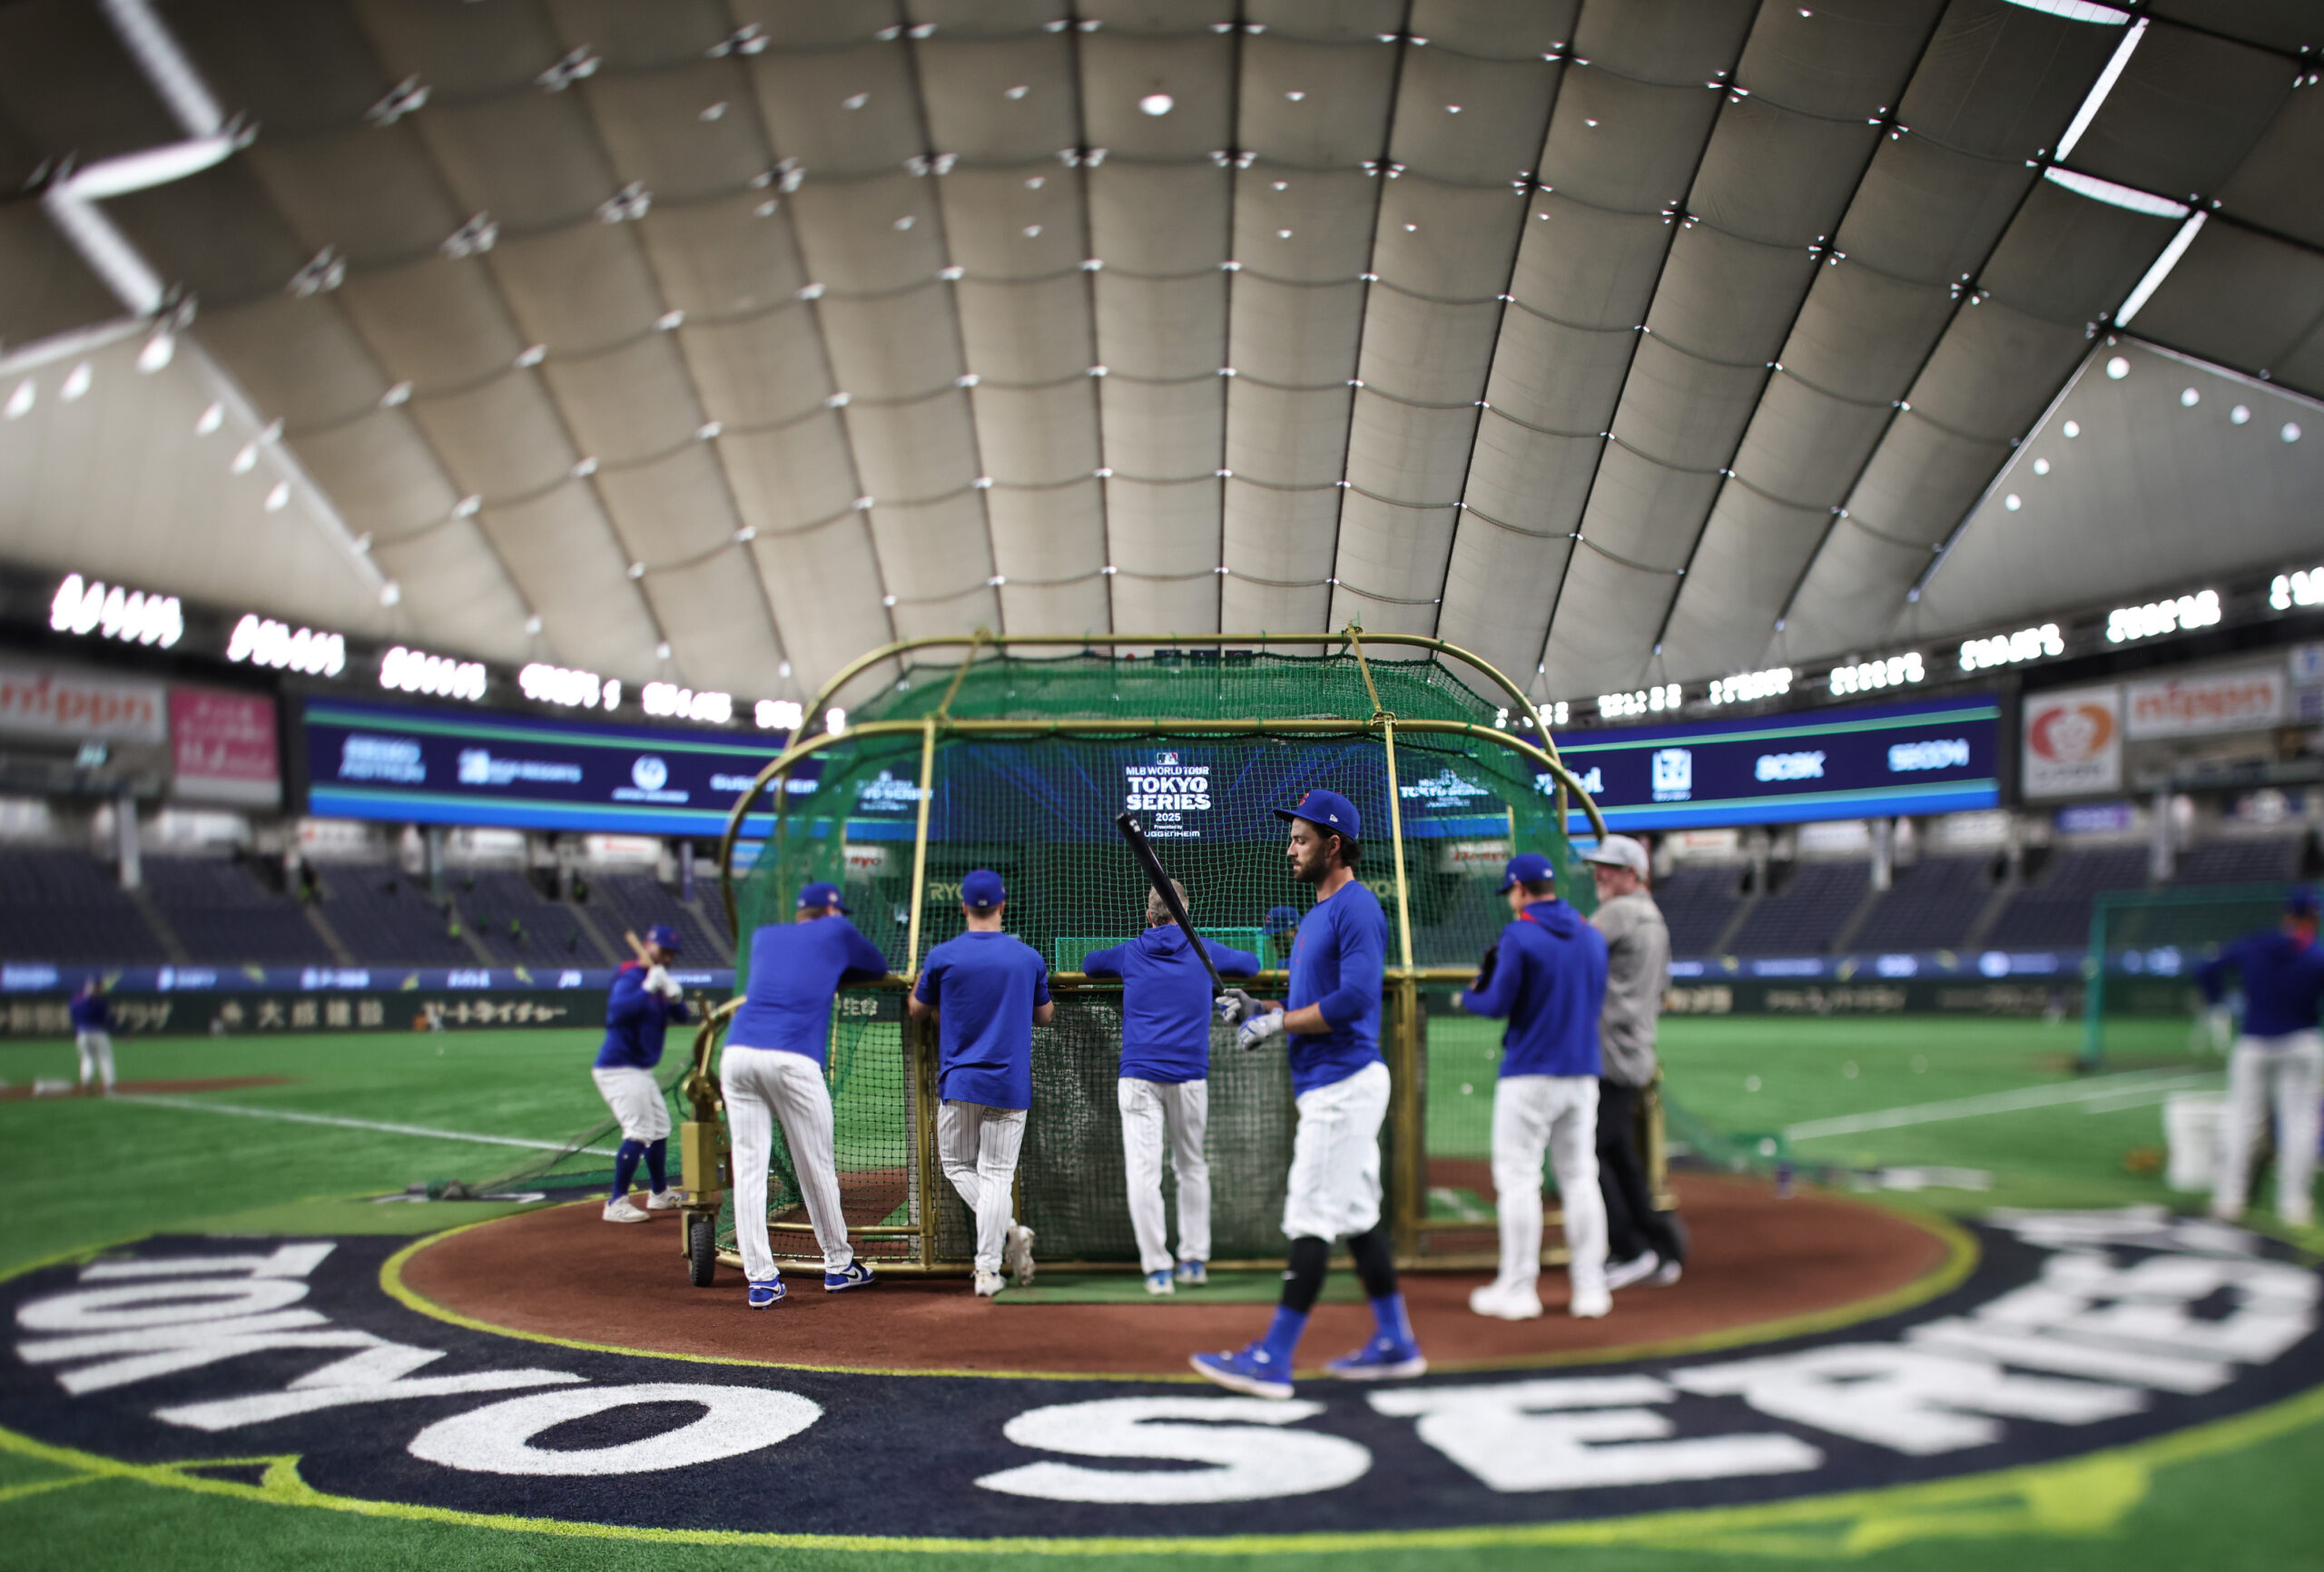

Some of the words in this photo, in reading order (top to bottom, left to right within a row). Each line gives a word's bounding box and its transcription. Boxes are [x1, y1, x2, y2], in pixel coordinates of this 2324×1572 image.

[1126, 766, 1146, 775] MLB
[1147, 766, 1182, 775] WORLD
[1183, 766, 1209, 775] TOUR
[1128, 777, 1208, 792] TOKYO
[1127, 794, 1211, 810] SERIES
[1156, 813, 1181, 821] 2025
